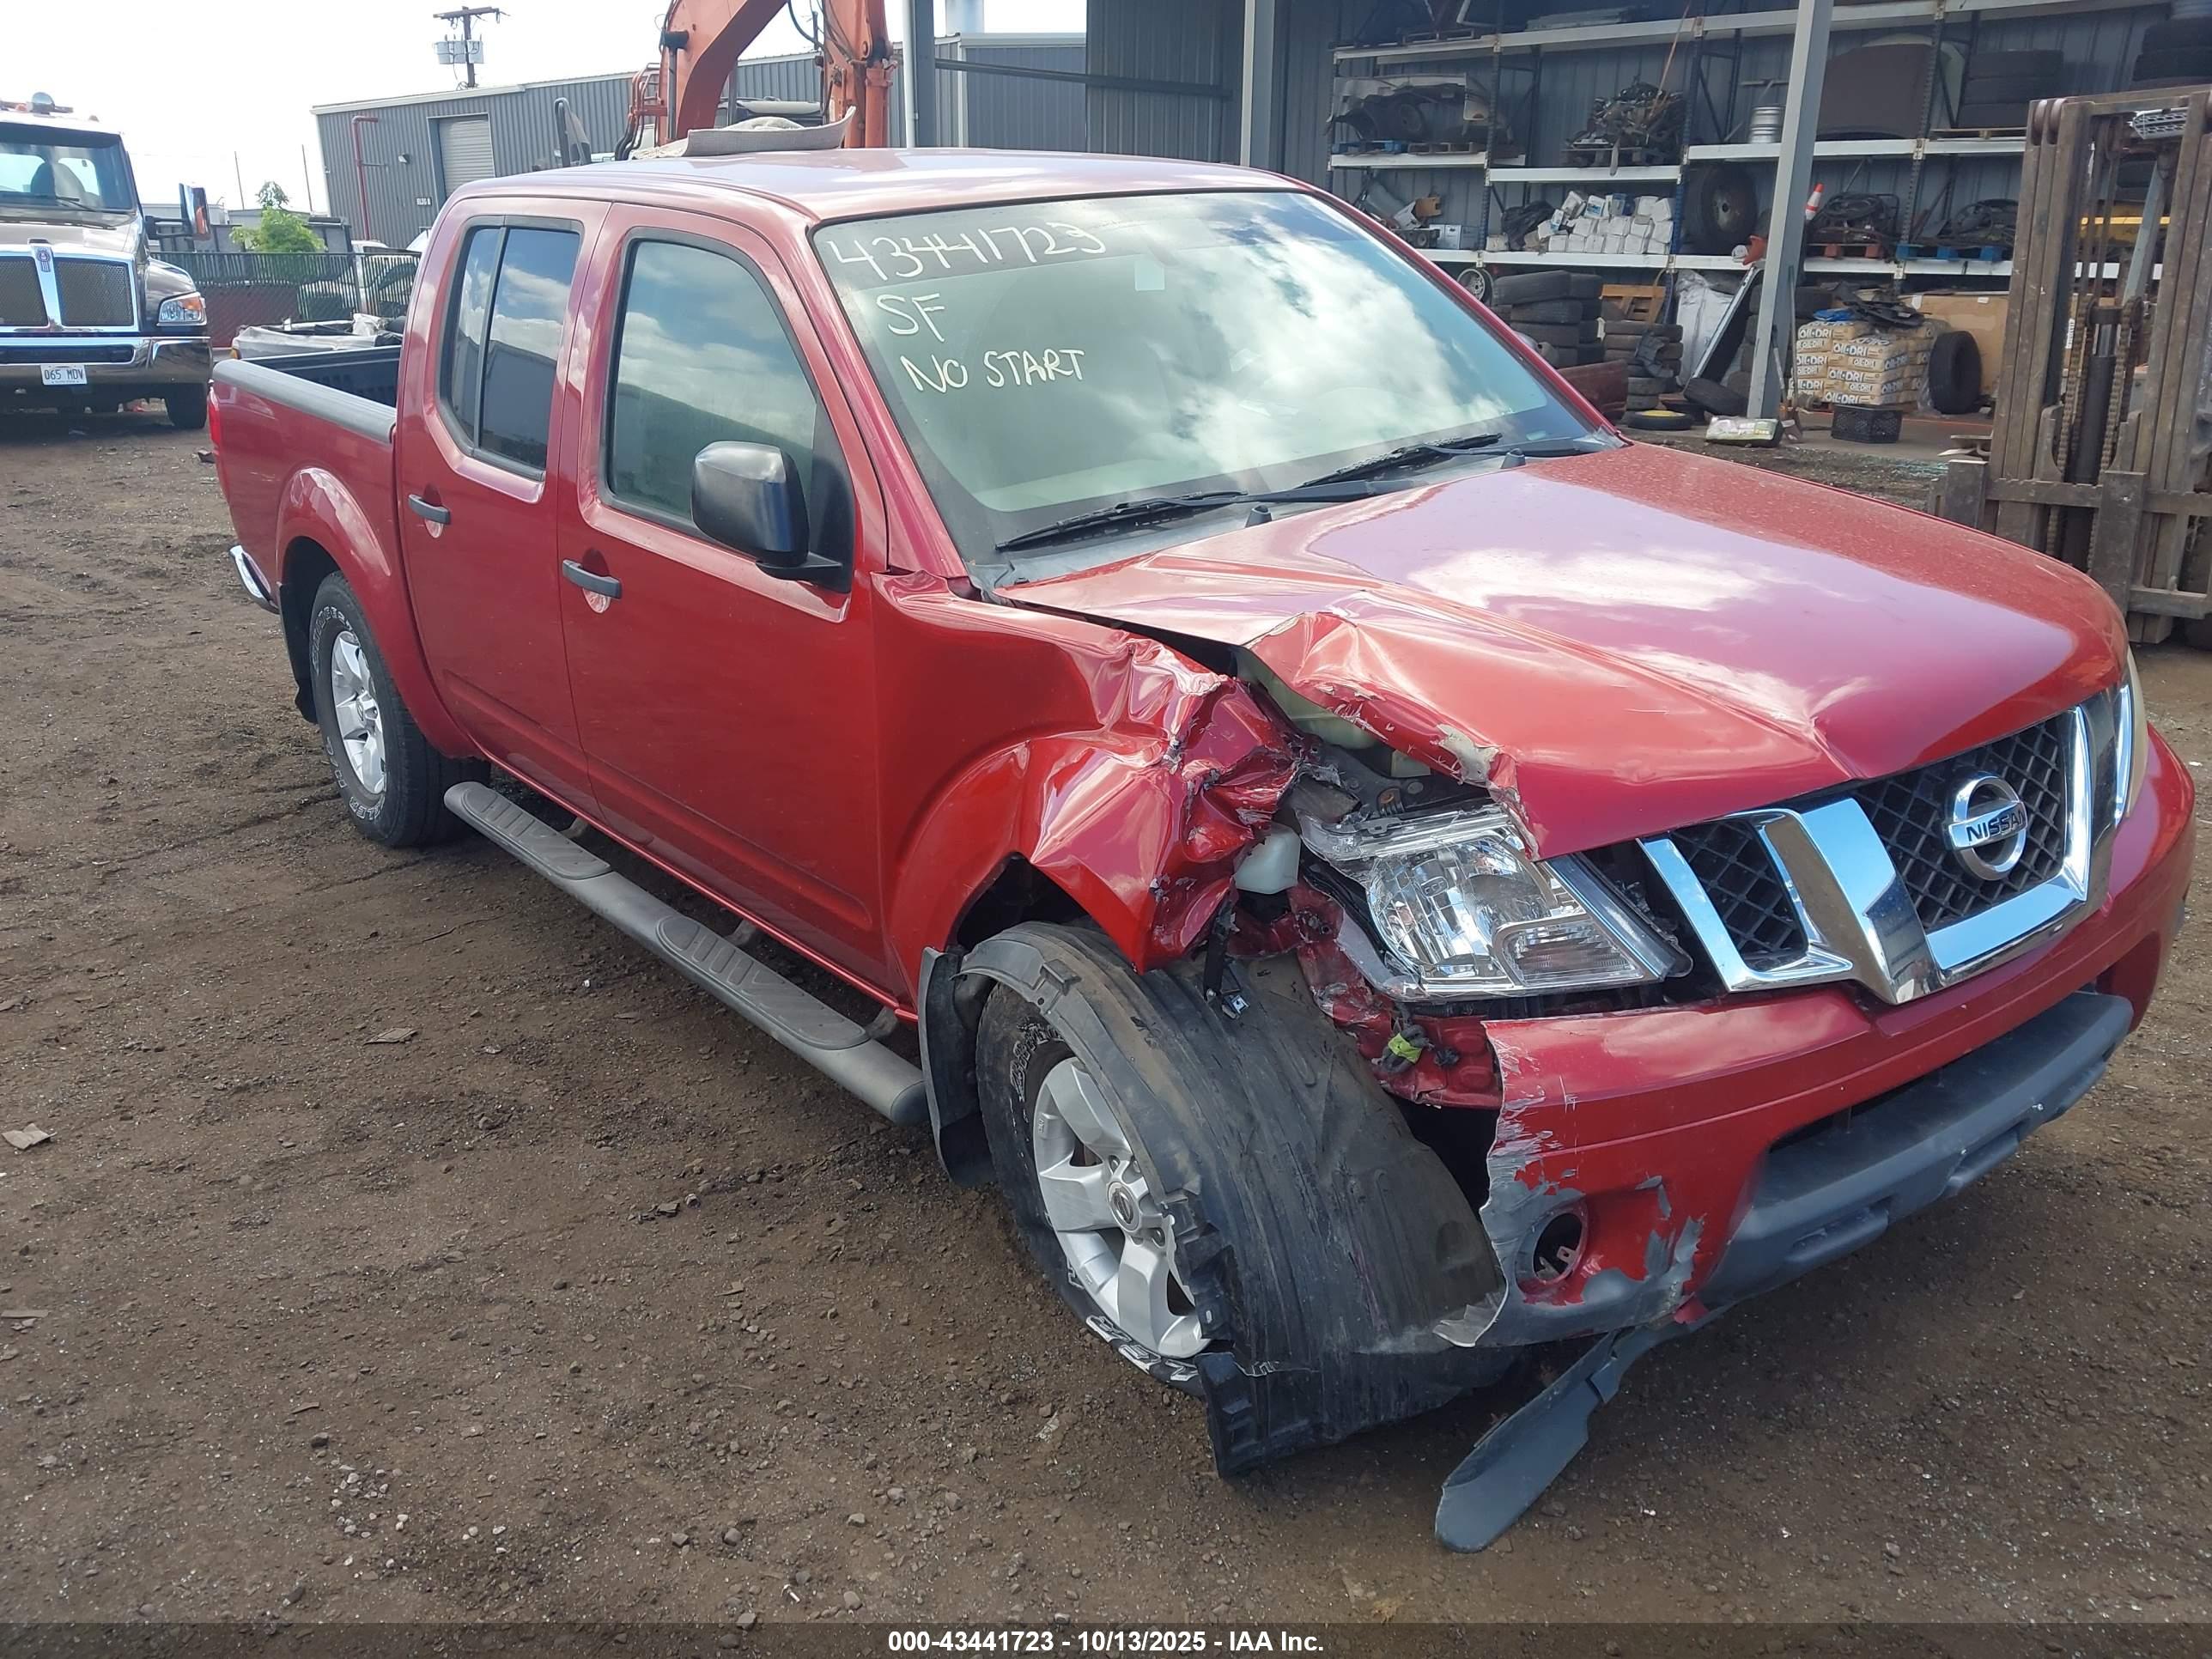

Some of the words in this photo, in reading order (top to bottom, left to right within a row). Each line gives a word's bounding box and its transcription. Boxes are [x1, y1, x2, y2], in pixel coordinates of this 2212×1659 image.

[827, 222, 1106, 281] 43441723
[876, 293, 945, 343] SF
[45, 369, 61, 380] 065
[900, 354, 969, 393] NO
[983, 349, 1085, 387] START
